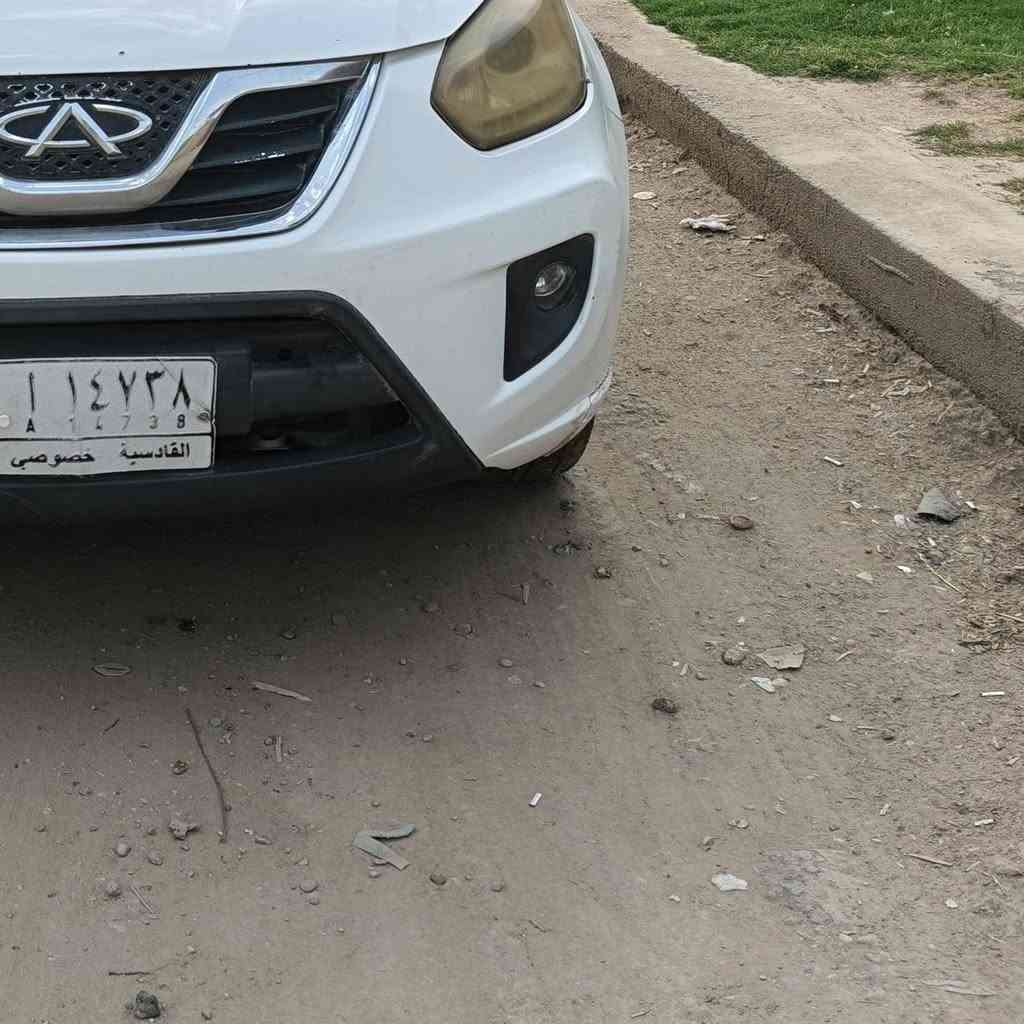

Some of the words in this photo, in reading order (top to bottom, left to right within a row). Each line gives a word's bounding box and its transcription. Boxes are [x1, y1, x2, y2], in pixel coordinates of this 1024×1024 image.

[68, 367, 192, 411] ١٤٧٣٨
[25, 418, 36, 433] A
[10, 448, 96, 471] خصوصي
[119, 441, 190, 466] القادسية
